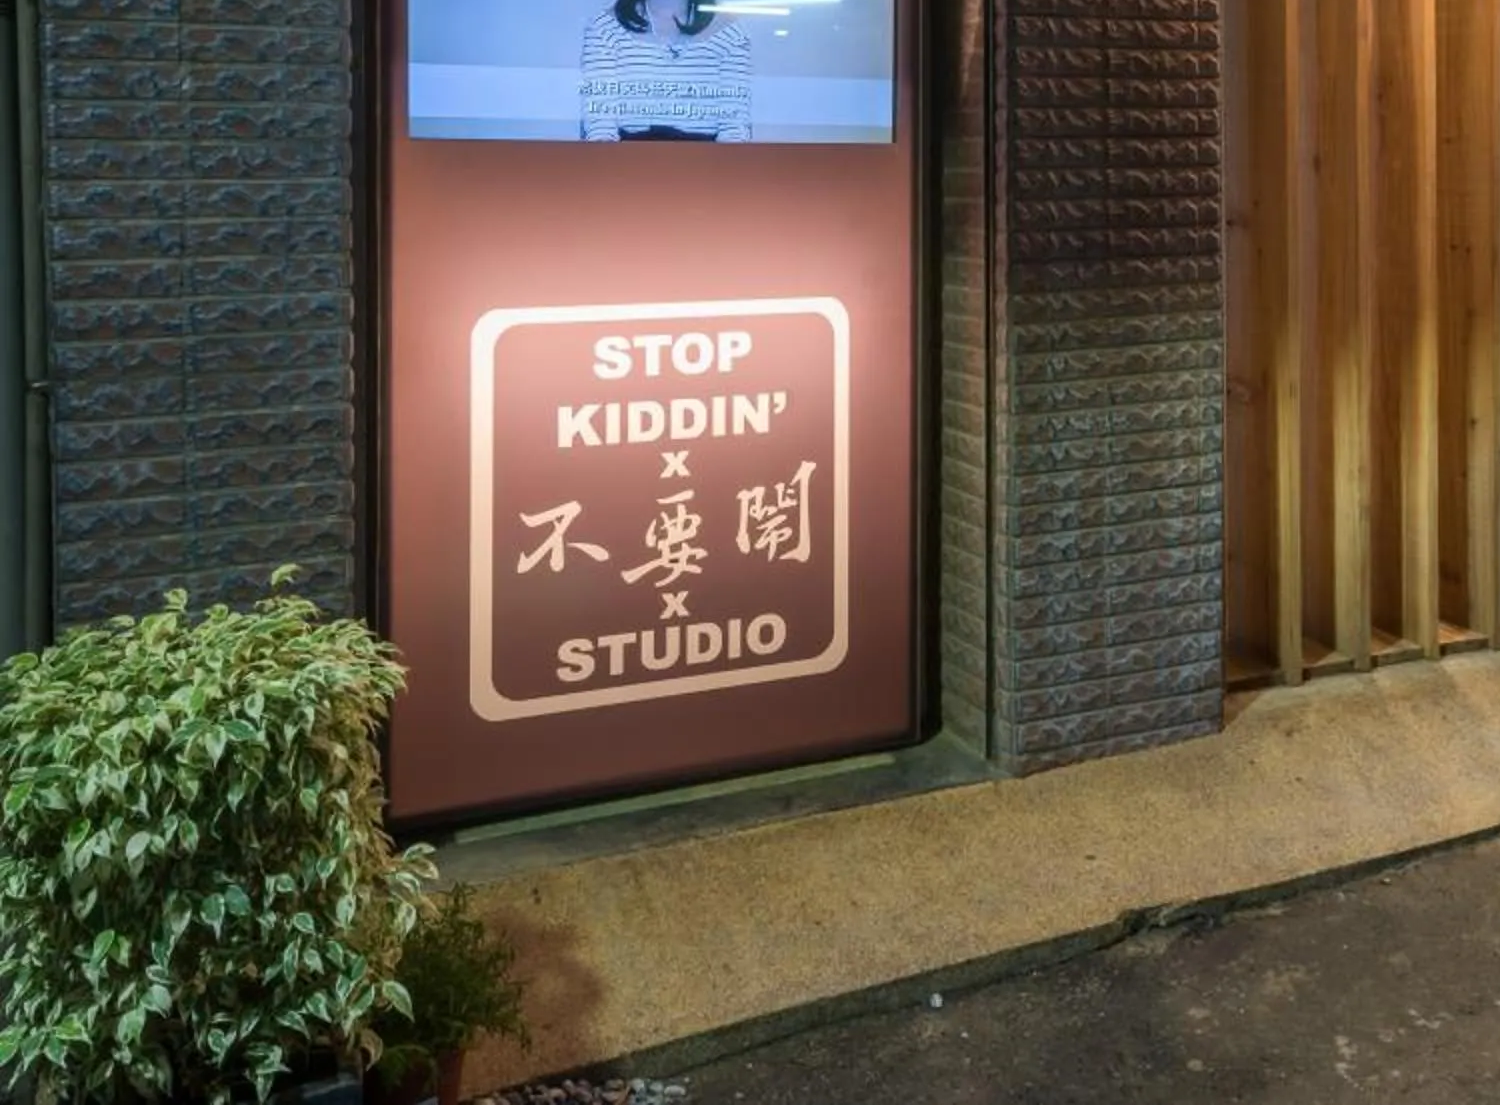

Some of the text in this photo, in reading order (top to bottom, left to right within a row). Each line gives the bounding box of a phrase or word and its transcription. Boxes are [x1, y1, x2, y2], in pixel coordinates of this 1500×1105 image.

[593, 331, 752, 379] STOP
[557, 392, 787, 448] KIDDIN’
[516, 460, 817, 588] 不要鬧
[556, 613, 787, 683] STUDIO
